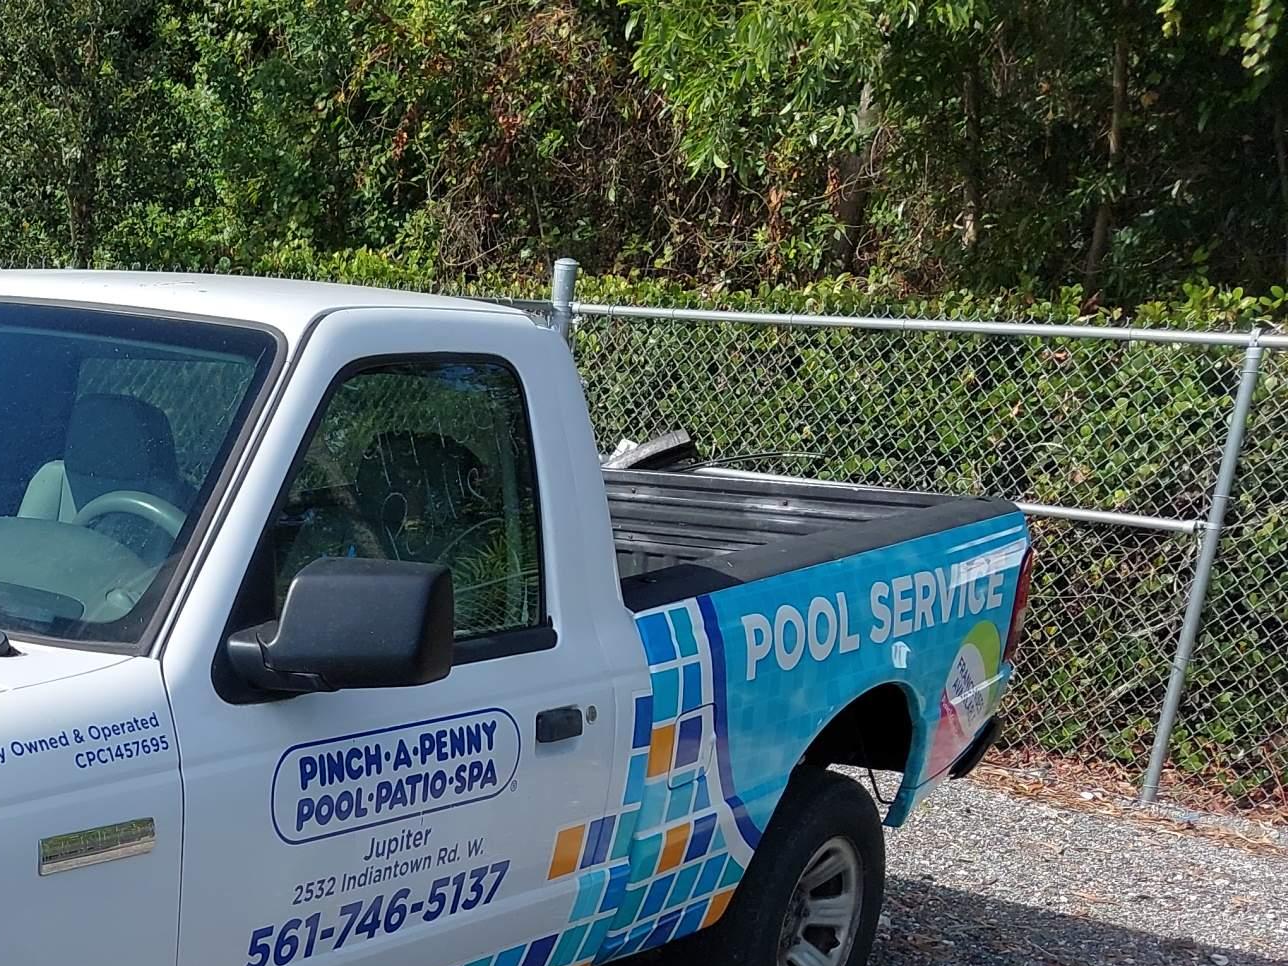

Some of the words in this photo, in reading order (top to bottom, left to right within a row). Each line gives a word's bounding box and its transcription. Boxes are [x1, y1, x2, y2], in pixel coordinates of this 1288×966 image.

[741, 591, 860, 681] POOL
[869, 558, 1005, 644] SERVICE
[10, 731, 70, 757] Owned
[72, 728, 85, 744] &
[87, 712, 160, 743] Operated
[74, 735, 170, 769] CPC1457695
[363, 826, 432, 861] Jupiter
[292, 876, 336, 906] 2532
[341, 855, 432, 893] Indiantown
[436, 844, 461, 864] Rd.
[467, 838, 485, 858] W.
